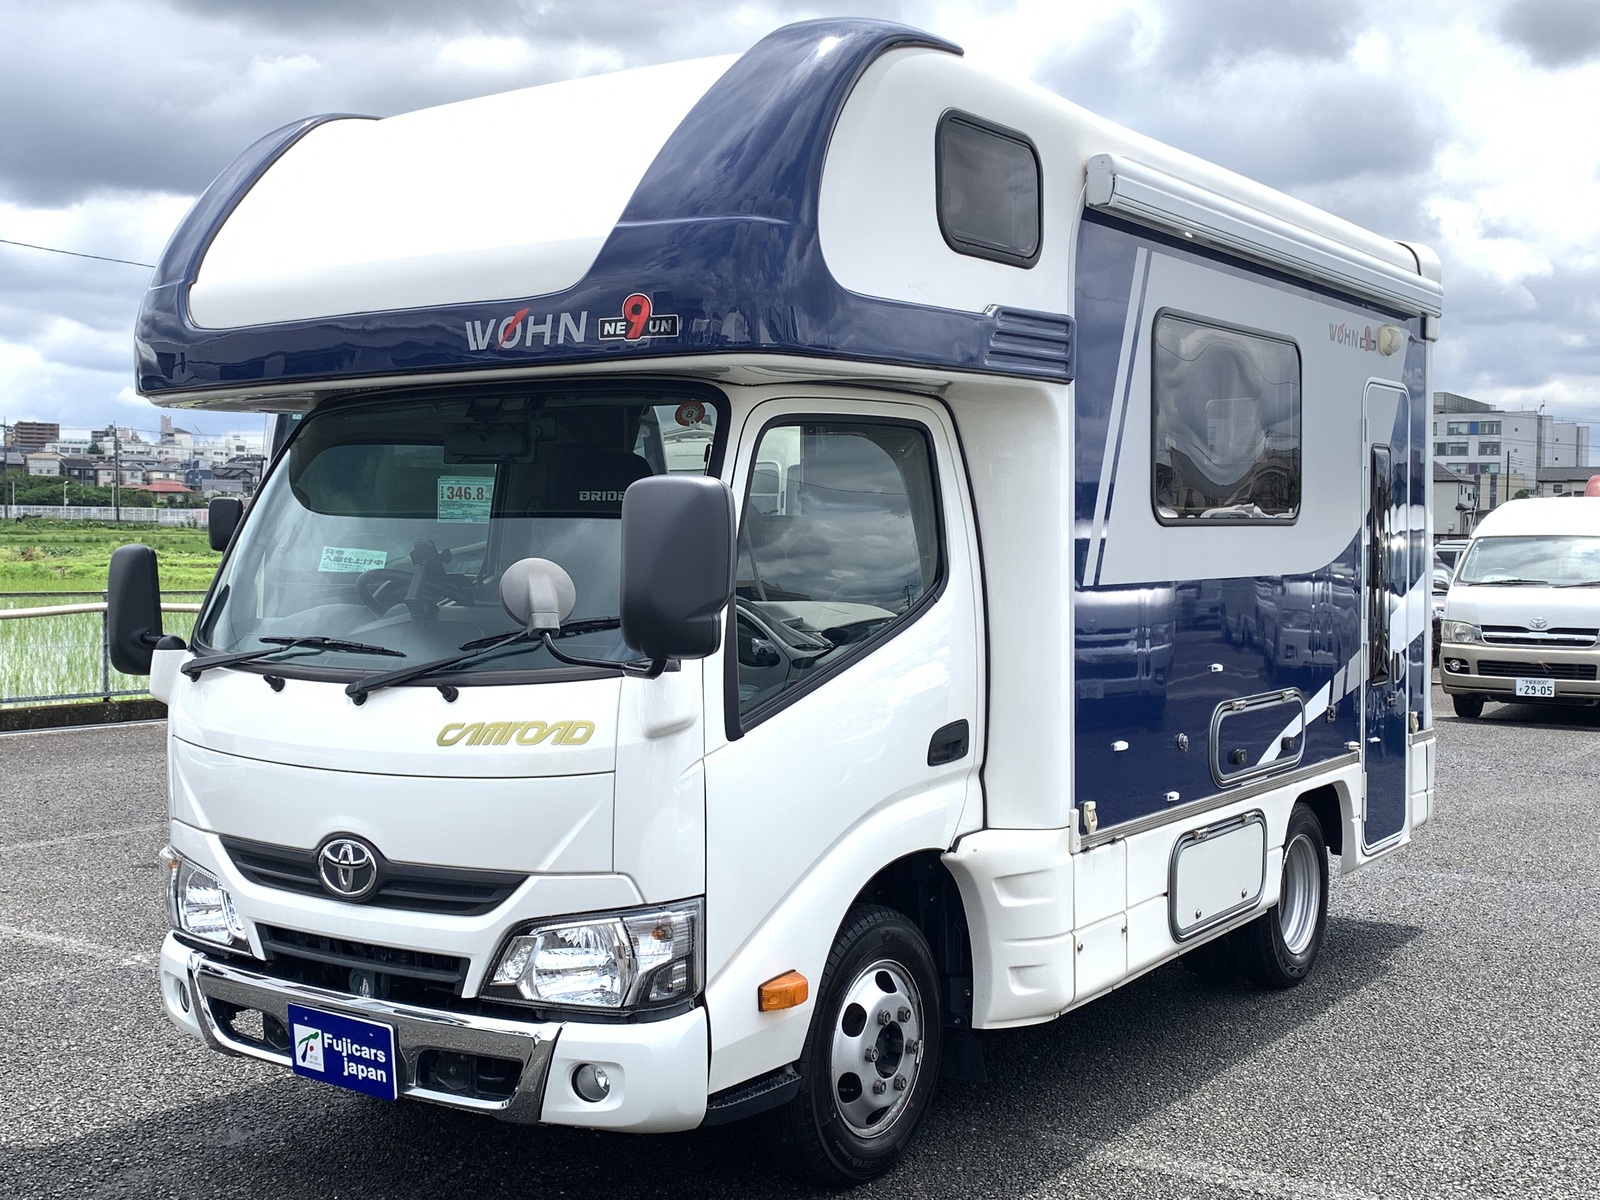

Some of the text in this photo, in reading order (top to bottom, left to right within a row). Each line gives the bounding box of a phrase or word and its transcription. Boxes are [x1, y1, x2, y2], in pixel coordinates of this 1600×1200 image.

[446, 485, 485, 501] 346.8
[323, 1032, 387, 1064] Fujicars
[343, 1057, 387, 1083] japan
